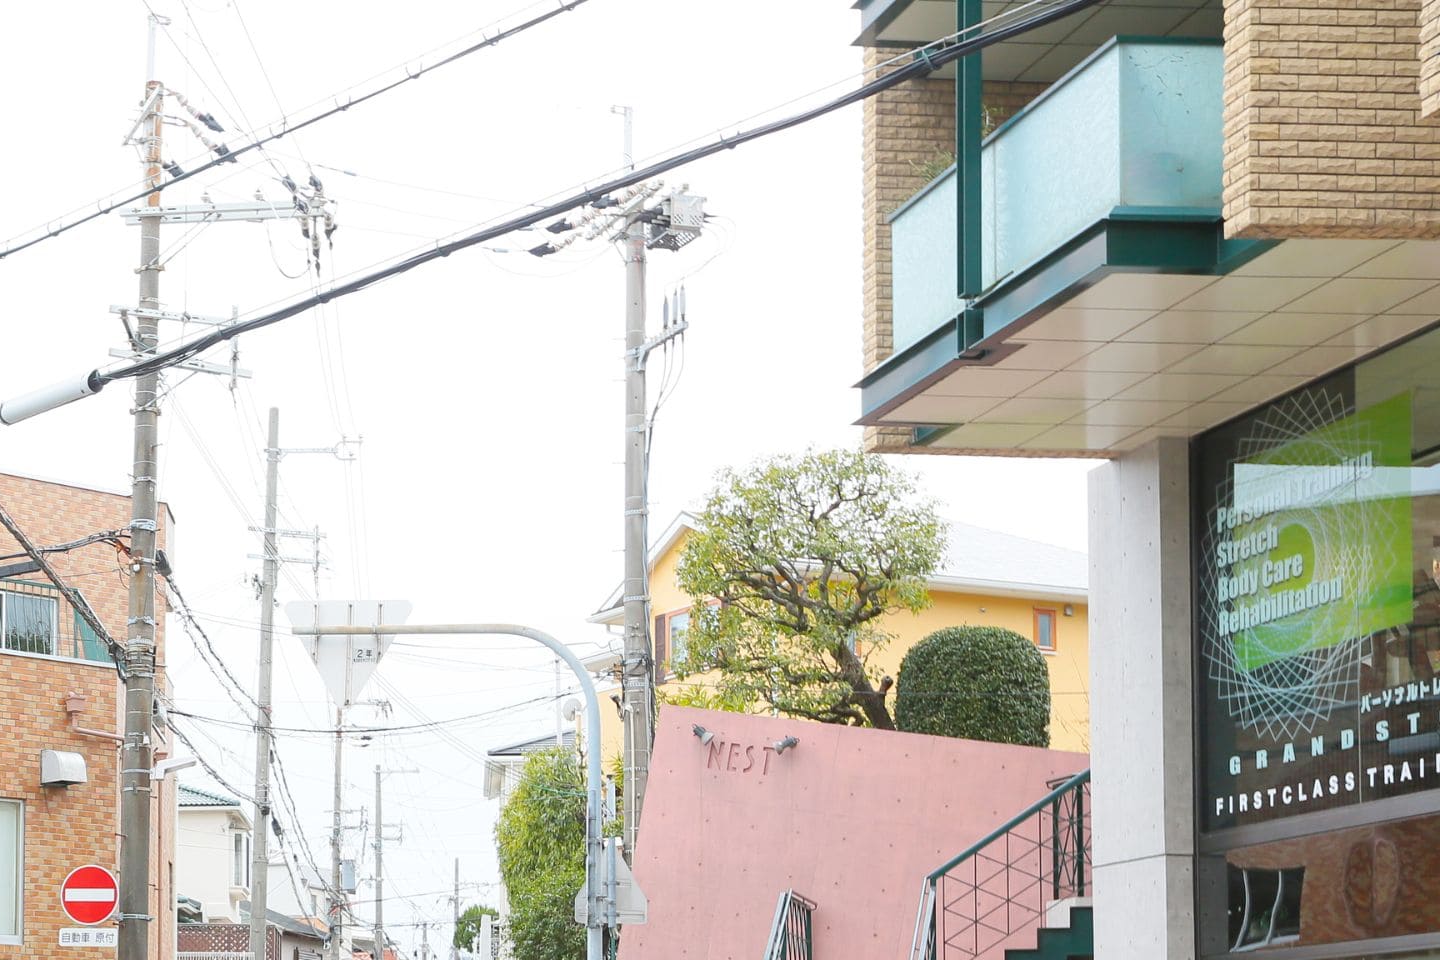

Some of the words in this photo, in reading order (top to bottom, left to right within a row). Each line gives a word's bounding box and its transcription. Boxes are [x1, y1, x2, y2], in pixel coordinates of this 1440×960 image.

[1217, 480, 1292, 533] Personal
[1295, 451, 1373, 502] Training
[1217, 523, 1278, 568] Stretch
[1218, 567, 1259, 603] Body
[1262, 554, 1303, 588] Care
[1219, 577, 1344, 637] Rehabilitation
[707, 740, 775, 775] NEST
[1229, 728, 1355, 775] GRAND
[1375, 712, 1440, 742] ST
[1216, 771, 1355, 816] FIRSTCLASS
[61, 932, 90, 943] 自動車
[96, 932, 115, 943] 原付
